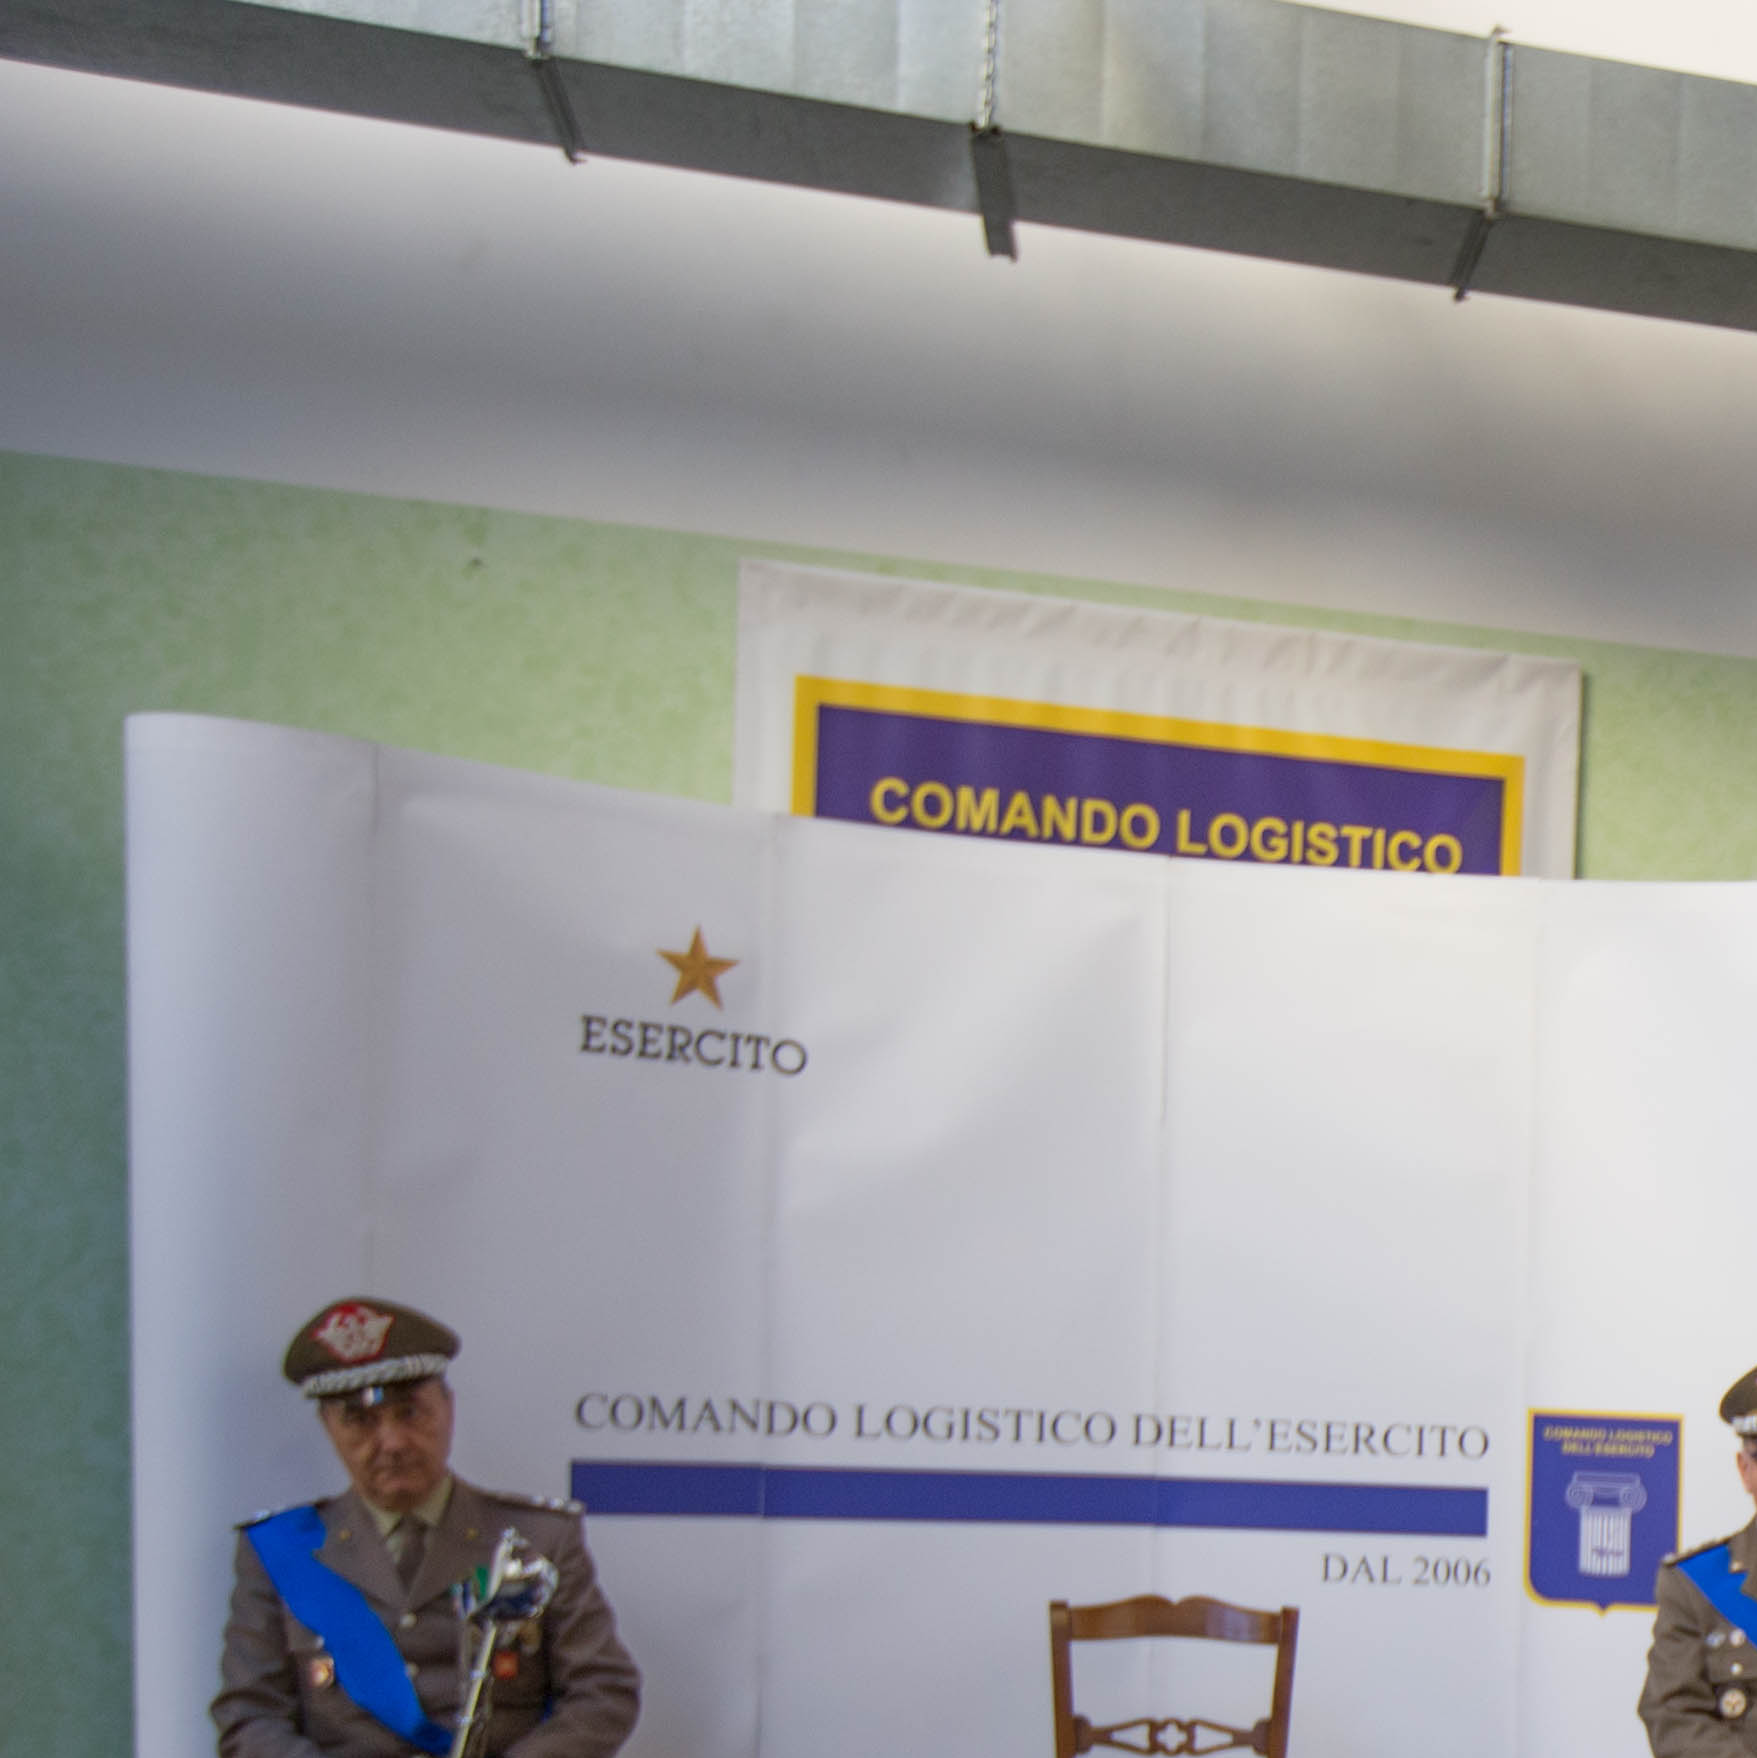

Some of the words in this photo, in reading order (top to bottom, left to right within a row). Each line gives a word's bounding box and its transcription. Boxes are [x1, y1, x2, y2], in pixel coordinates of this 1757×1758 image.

[870, 776, 1160, 850] COMANDO
[1176, 809, 1464, 874] LOGISTICO
[580, 1014, 807, 1075] ESERCITO
[575, 1392, 838, 1438] COMANDO
[855, 1402, 1117, 1446] LOGISTICO
[1132, 1411, 1490, 1460] DELL'ESERCITO
[1321, 1552, 1401, 1585] DAL
[1412, 1555, 1491, 1586] 2006
